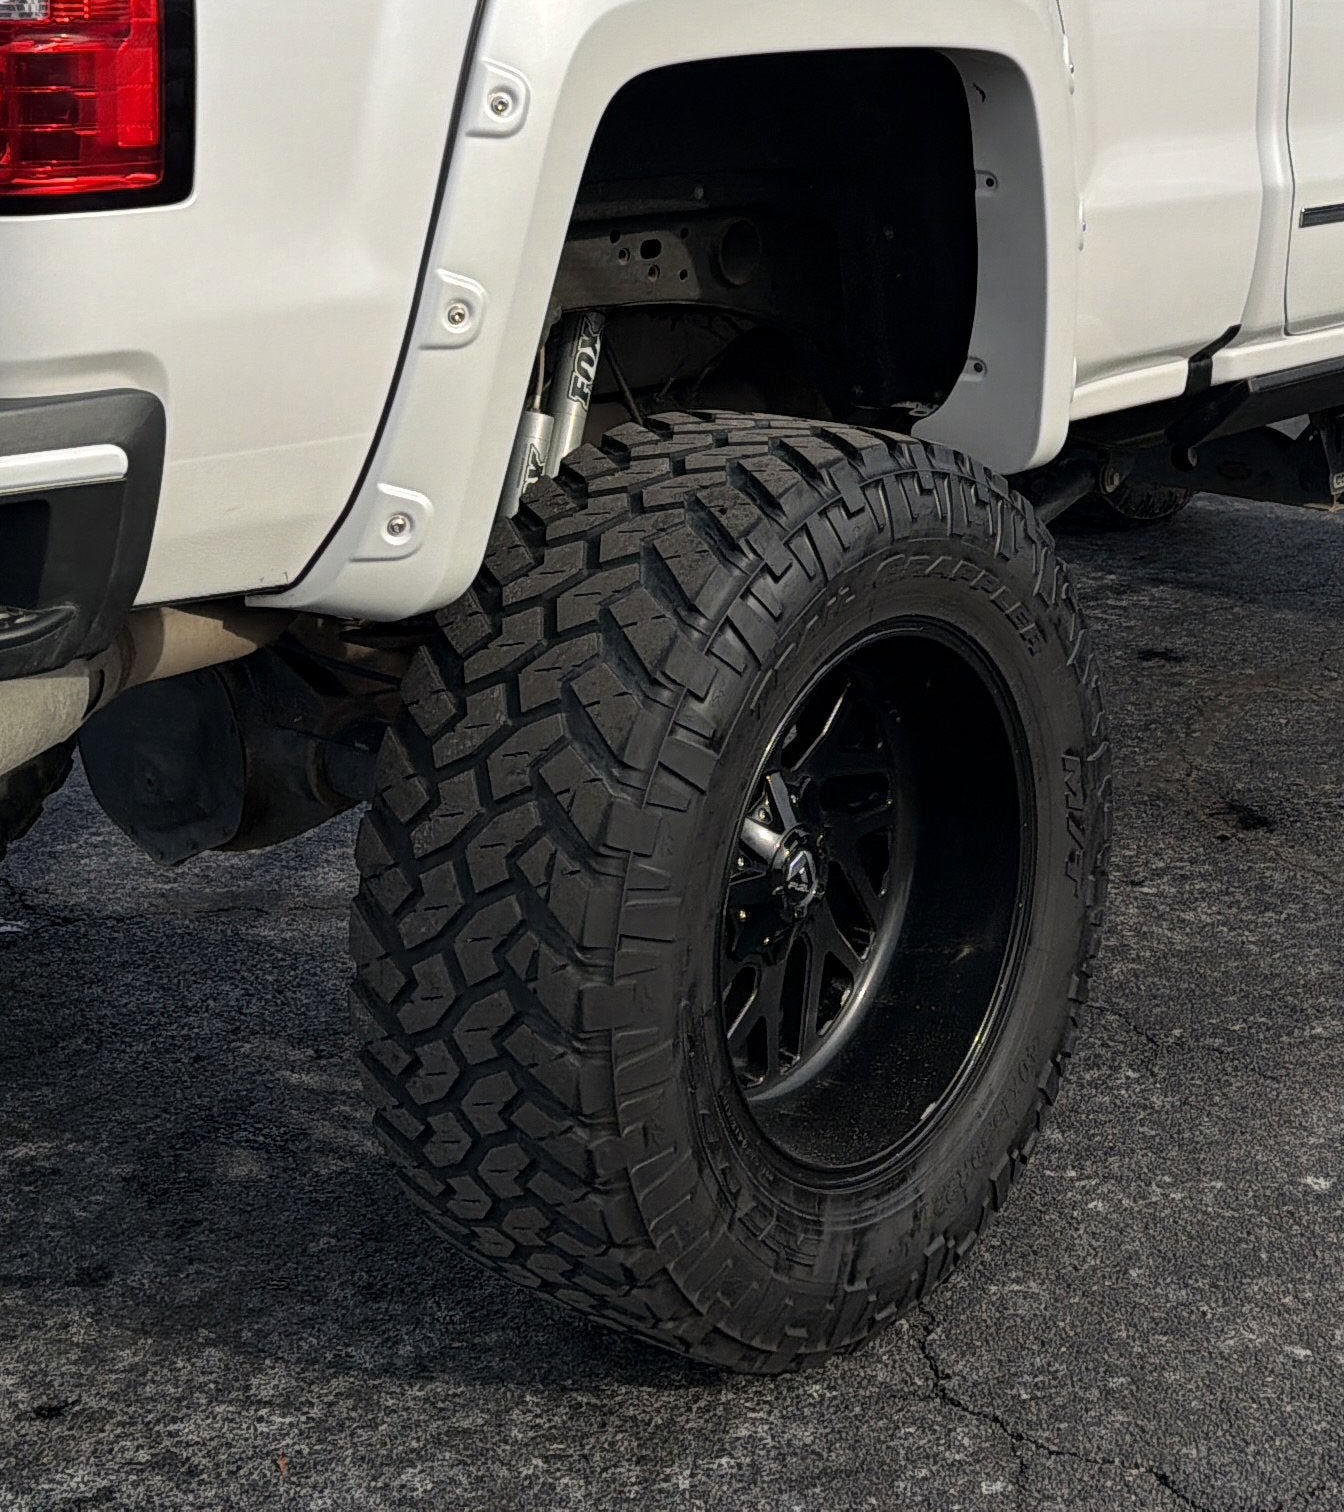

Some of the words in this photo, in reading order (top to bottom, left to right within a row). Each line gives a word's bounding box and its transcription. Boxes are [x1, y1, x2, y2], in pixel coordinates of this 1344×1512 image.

[567, 315, 603, 413] FOX
[872, 552, 1048, 658] GRAPPLER
[1060, 748, 1087, 900] M/T
